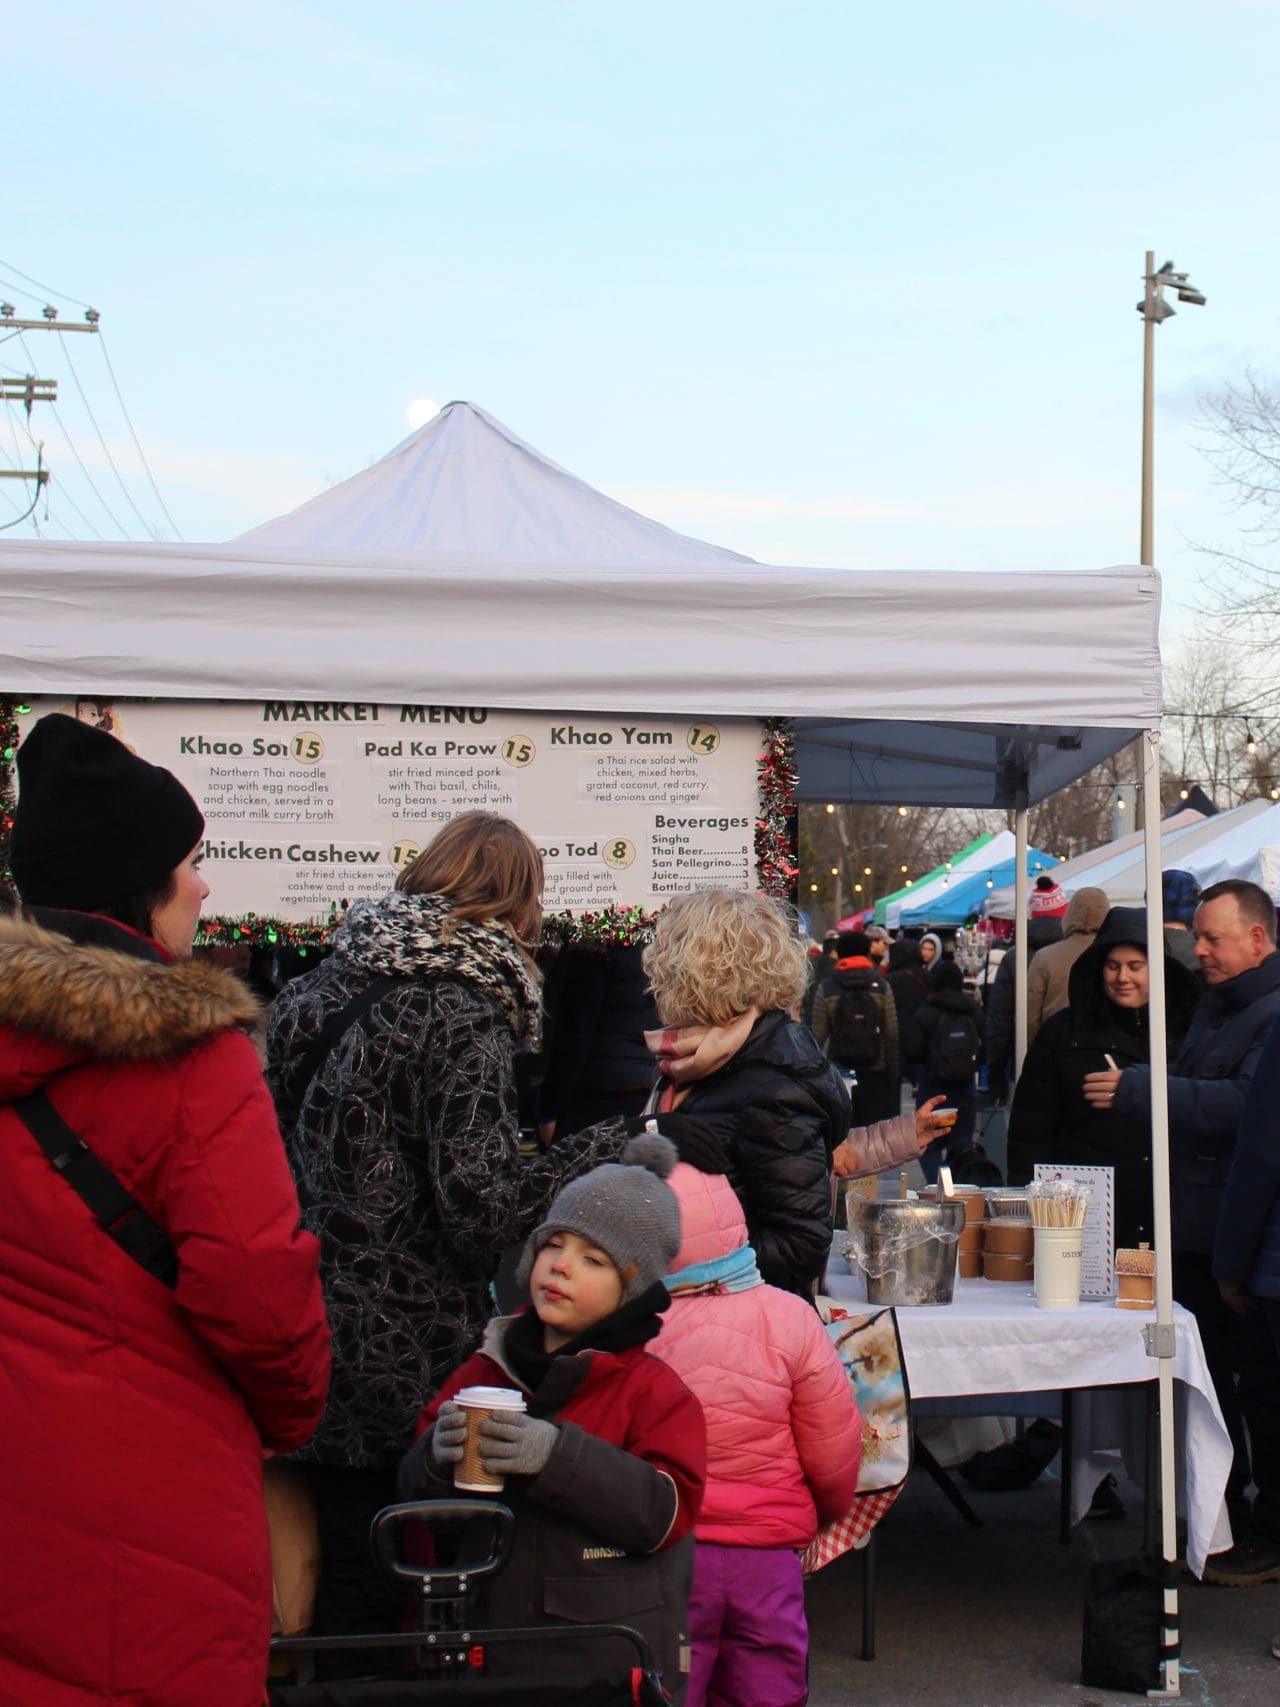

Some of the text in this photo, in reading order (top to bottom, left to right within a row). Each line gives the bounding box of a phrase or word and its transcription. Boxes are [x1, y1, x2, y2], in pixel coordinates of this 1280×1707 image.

[263, 702, 488, 724] MARKET MENU
[551, 726, 673, 745] Khao Yam
[690, 728, 716, 751] 14
[180, 735, 243, 756] Khao
[295, 738, 321, 759] 15
[365, 741, 497, 757] Pad Ka Prow
[505, 740, 531, 763] 15
[597, 755, 698, 765] a Thai rice salad with
[210, 766, 326, 779] Northern Thai noodle
[388, 766, 502, 781] stir fried minced pork
[597, 767, 698, 778] chicken, mixed herbs,
[208, 780, 329, 794] soup with egg noodles
[389, 780, 501, 792] with Thai basil, chilis,
[586, 780, 709, 791] grated coconut, red curry,
[203, 794, 334, 807] and chicken, served in a
[378, 794, 401, 807] long
[405, 794, 437, 805] beans
[451, 794, 487, 805] served
[490, 794, 512, 805] with
[595, 792, 700, 804] red onions and ginger
[203, 808, 334, 821] coconut milk curry broth
[392, 810, 398, 818] a
[402, 808, 427, 818] fried
[431, 810, 452, 821] egg
[655, 815, 749, 831] Beverages
[652, 834, 689, 845] Singha
[200, 839, 380, 863] hicken Cashew
[565, 841, 598, 857] Tod
[612, 841, 627, 859] 8
[652, 846, 674, 855] Thai
[652, 858, 672, 868] San
[296, 869, 397, 879] stir fried chicken with
[566, 871, 590, 880] filled
[592, 871, 612, 880] with
[288, 882, 323, 891] cashew
[326, 882, 345, 891] and
[357, 882, 393, 893] medley
[559, 883, 593, 895] ground
[596, 883, 618, 895] pork
[652, 882, 691, 892] Bottled
[563, 896, 585, 905] sour
[587, 896, 614, 905] sauce
